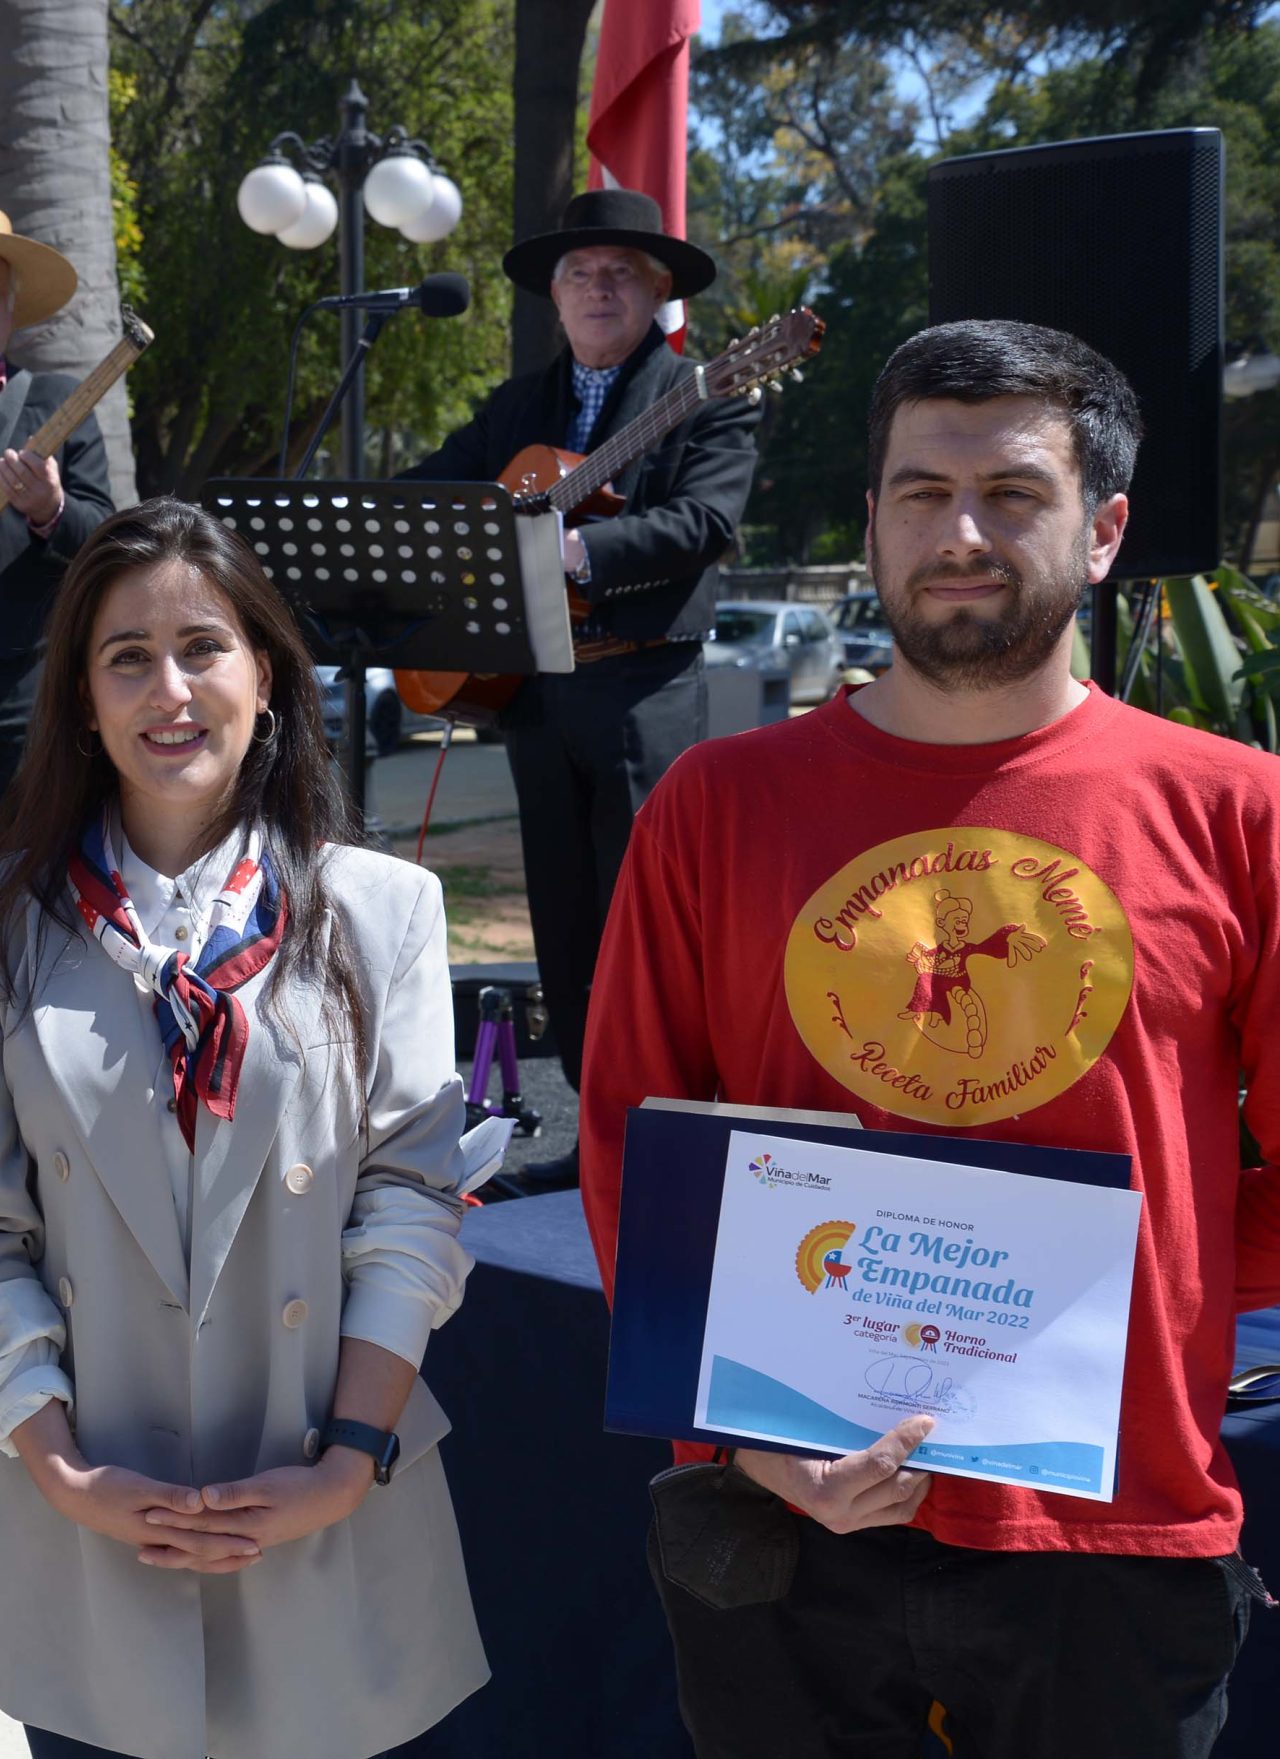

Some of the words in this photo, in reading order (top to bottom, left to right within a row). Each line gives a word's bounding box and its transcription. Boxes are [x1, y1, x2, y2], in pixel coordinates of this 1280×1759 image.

[814, 843, 999, 951] Empanadas
[851, 1041, 933, 1101] Receta
[945, 1043, 1057, 1109] Familiar
[766, 1166, 832, 1185] ViñadelMar
[876, 1210, 920, 1223] DIPLOMA
[923, 1217, 936, 1226] DE
[938, 1220, 975, 1231] HONOR
[858, 1226, 901, 1255] La
[909, 1232, 1009, 1269] Mejor
[857, 1257, 1034, 1308] Empanada
[852, 1288, 873, 1302] de
[875, 1292, 912, 1310] Viña
[915, 1299, 942, 1315] del
[945, 1303, 985, 1321] Mar
[986, 1311, 1030, 1329] 2022
[863, 1316, 900, 1333] lugar
[853, 1329, 898, 1343] categoría
[945, 1330, 986, 1346] Horno
[944, 1342, 1018, 1364] Tradicional
